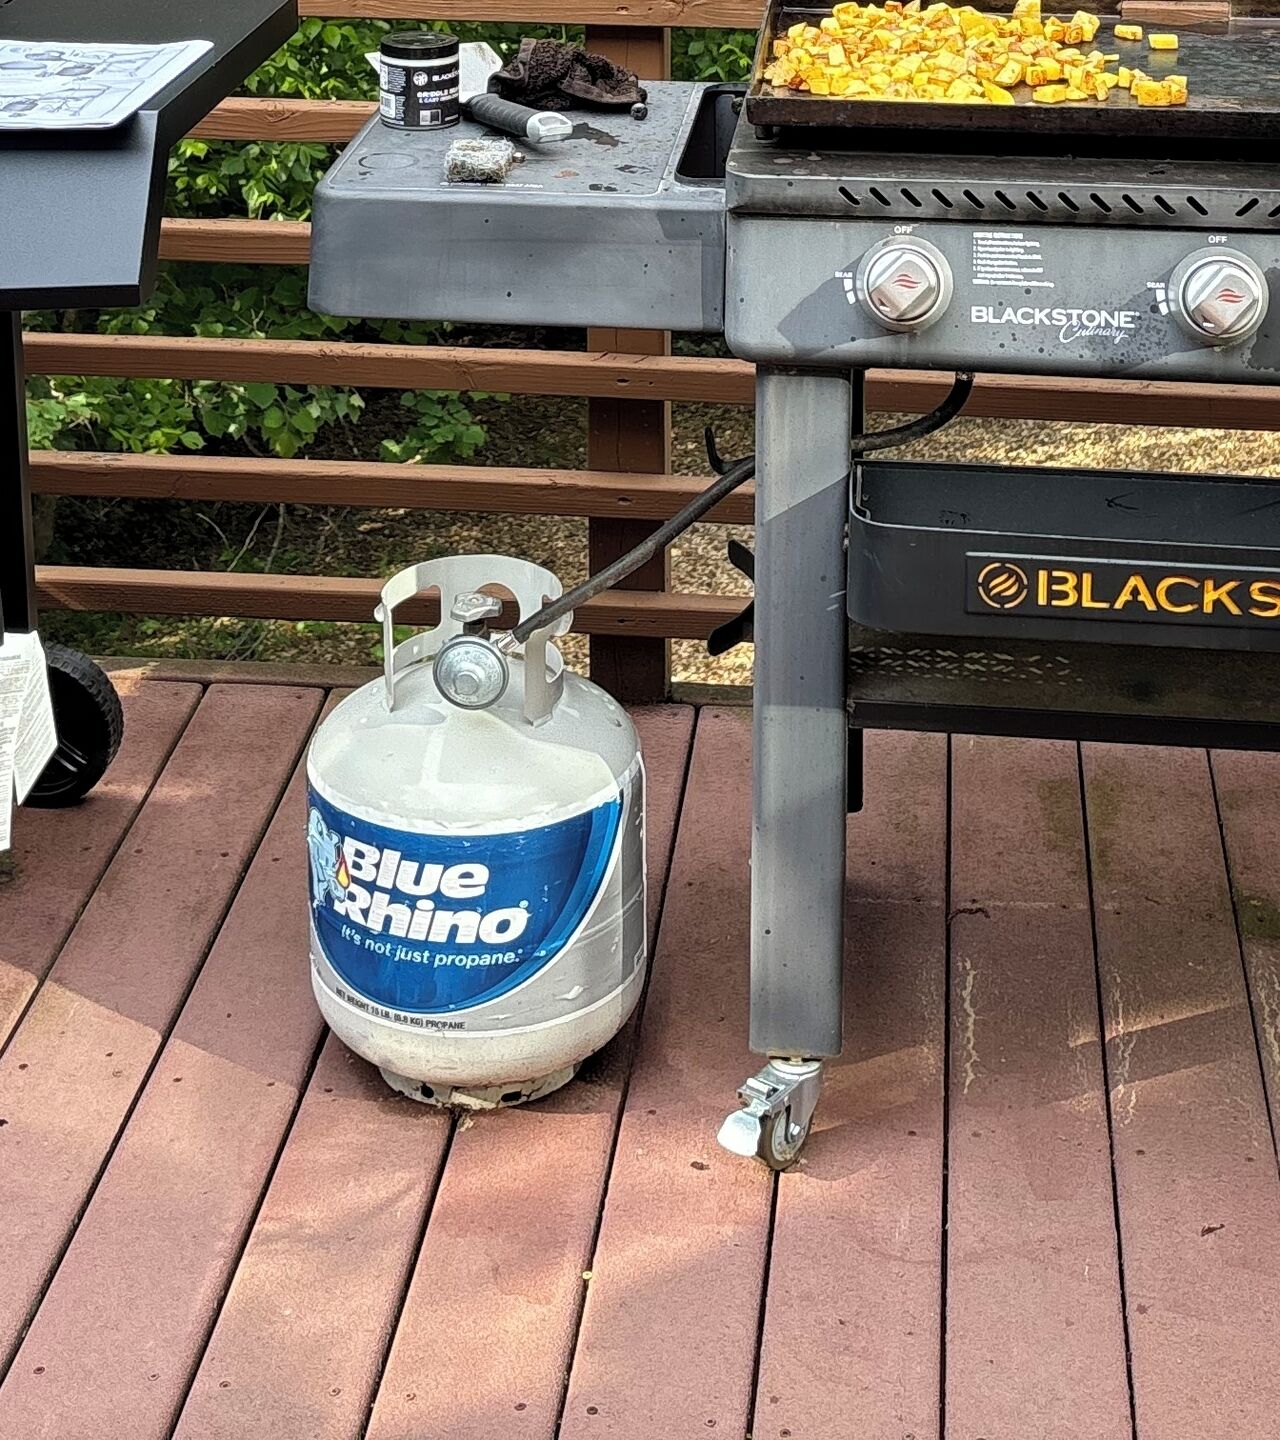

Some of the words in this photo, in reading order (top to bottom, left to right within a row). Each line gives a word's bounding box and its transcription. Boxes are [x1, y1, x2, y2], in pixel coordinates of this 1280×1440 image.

[894, 225, 913, 234] OFF
[1208, 235, 1227, 244] OFF
[971, 305, 1135, 329] BLACKSTONE
[1059, 320, 1129, 344] Culinary
[343, 835, 490, 899] Blue
[333, 882, 530, 944] Rhino
[340, 924, 362, 946] It's
[364, 938, 392, 957] not
[394, 945, 430, 964] just
[347, 994, 369, 1012] WEIGHT
[371, 1006, 379, 1015] 15
[410, 1017, 423, 1027] KG)
[426, 1021, 466, 1030] PROPANE
